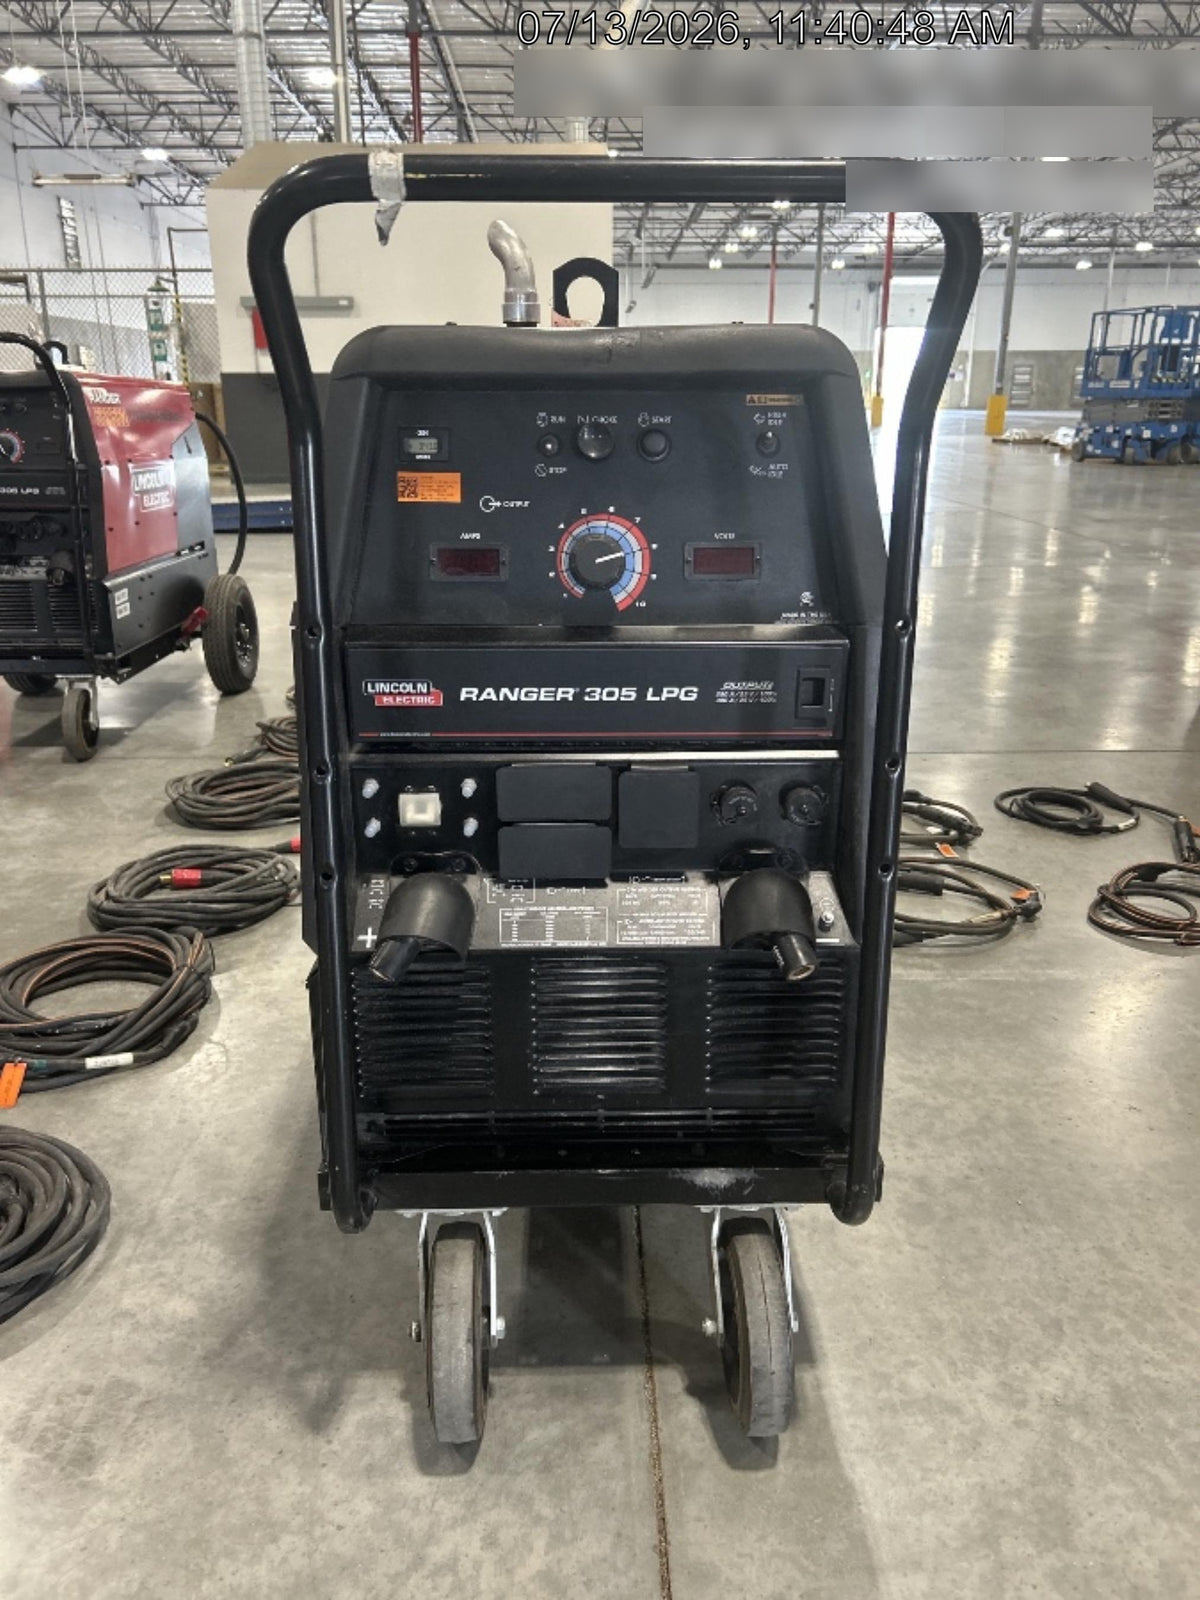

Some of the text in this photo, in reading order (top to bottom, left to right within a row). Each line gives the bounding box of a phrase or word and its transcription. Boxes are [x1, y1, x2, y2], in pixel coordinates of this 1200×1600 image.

[367, 681, 428, 694] LINCOLN
[459, 687, 576, 702] RANGER
[583, 687, 638, 702] 305
[645, 686, 699, 702] LPG
[382, 695, 437, 705] ELECTRIC
